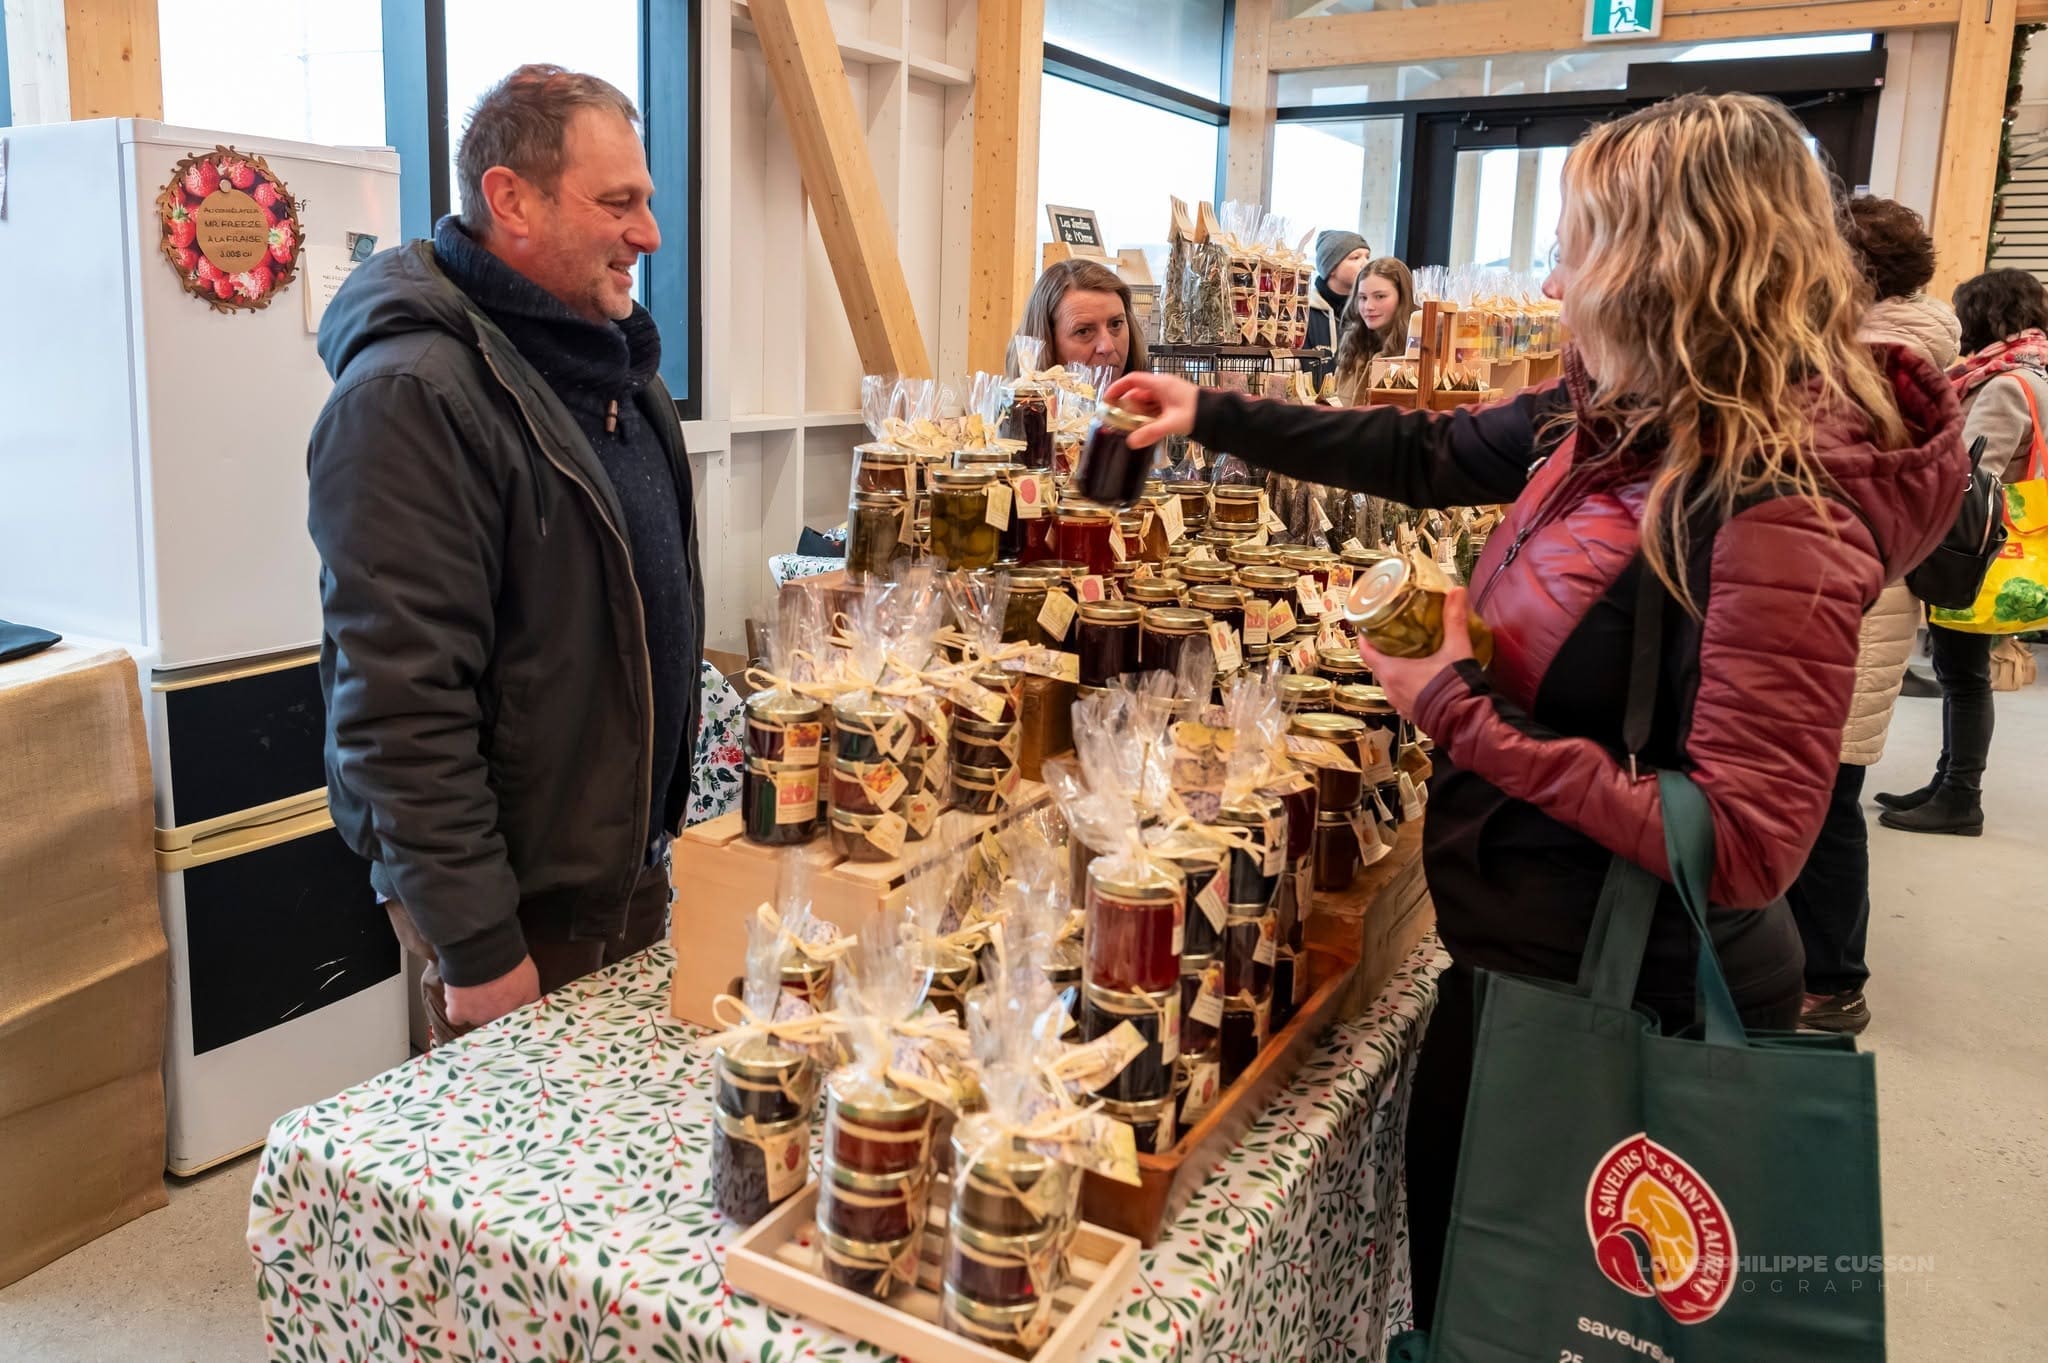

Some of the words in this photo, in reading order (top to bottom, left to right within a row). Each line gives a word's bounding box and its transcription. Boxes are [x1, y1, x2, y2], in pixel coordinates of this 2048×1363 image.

[221, 220, 262, 228] FREEZE
[226, 235, 262, 243] FRAISE
[1065, 230, 1073, 241] de
[1597, 1149, 1643, 1218] SAVEURS
[1642, 1145, 1725, 1302] S-SAINT-LAURENT
